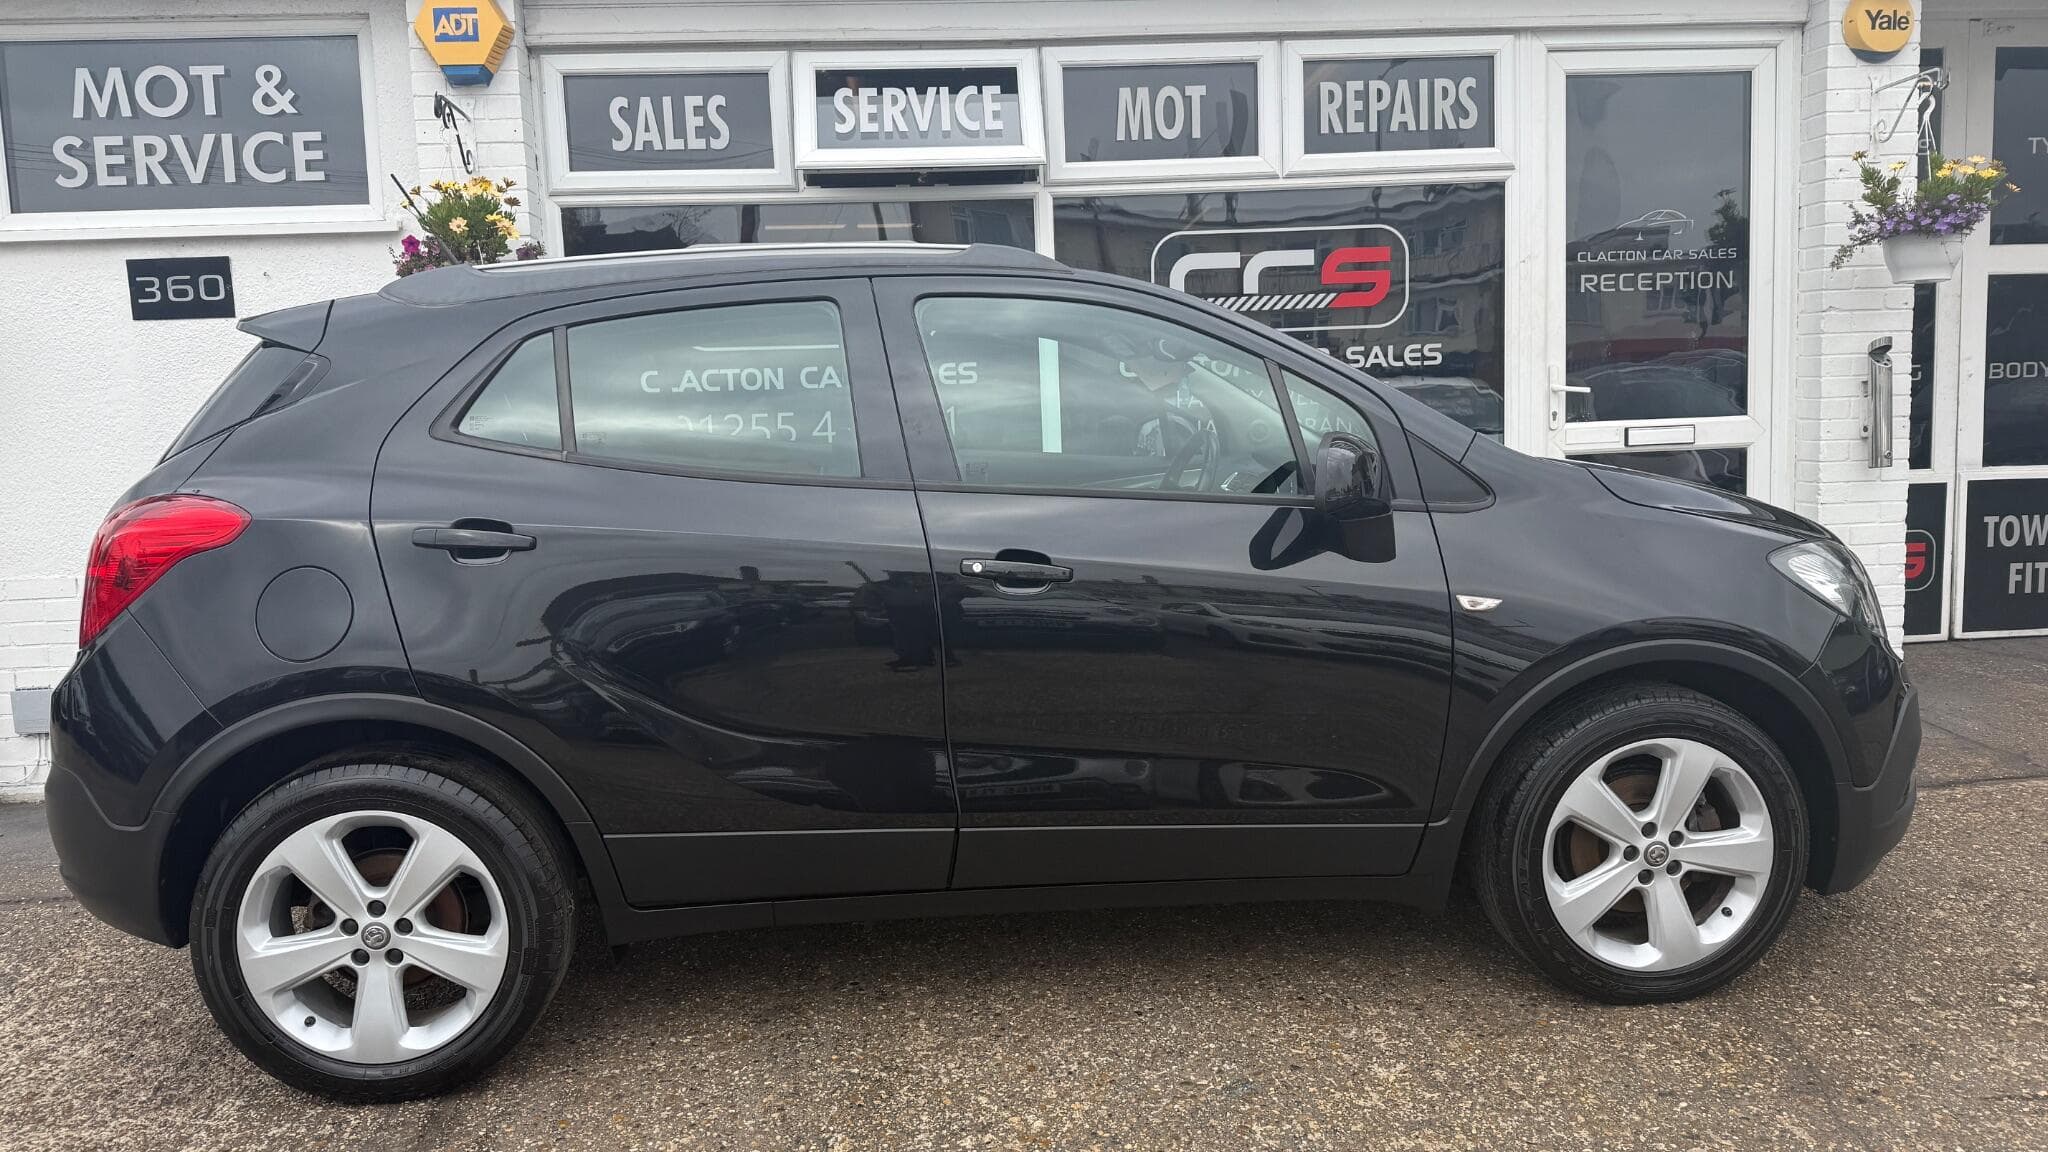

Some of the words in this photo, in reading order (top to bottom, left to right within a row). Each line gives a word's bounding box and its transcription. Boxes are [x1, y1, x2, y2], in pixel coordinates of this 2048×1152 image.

[435, 13, 478, 36] ADT
[72, 65, 225, 119] MOT
[252, 64, 298, 116] &
[1319, 77, 1479, 135] REPAIRS
[608, 95, 731, 152] SALES
[833, 85, 1004, 135] SERVICE
[1116, 85, 1207, 142] MOT
[52, 131, 326, 188] SERVICE
[1577, 250, 1648, 263] CLACTON
[1652, 249, 1683, 261] CAR
[1688, 248, 1738, 260] SALES
[135, 274, 226, 303] 360
[1580, 270, 1734, 293] RECEPTION
[1345, 343, 1443, 369] SALES
[640, 367, 785, 393] CACTON
[799, 366, 843, 389] CA
[1983, 514, 2048, 548] TOW
[2008, 561, 2048, 594] FIT
